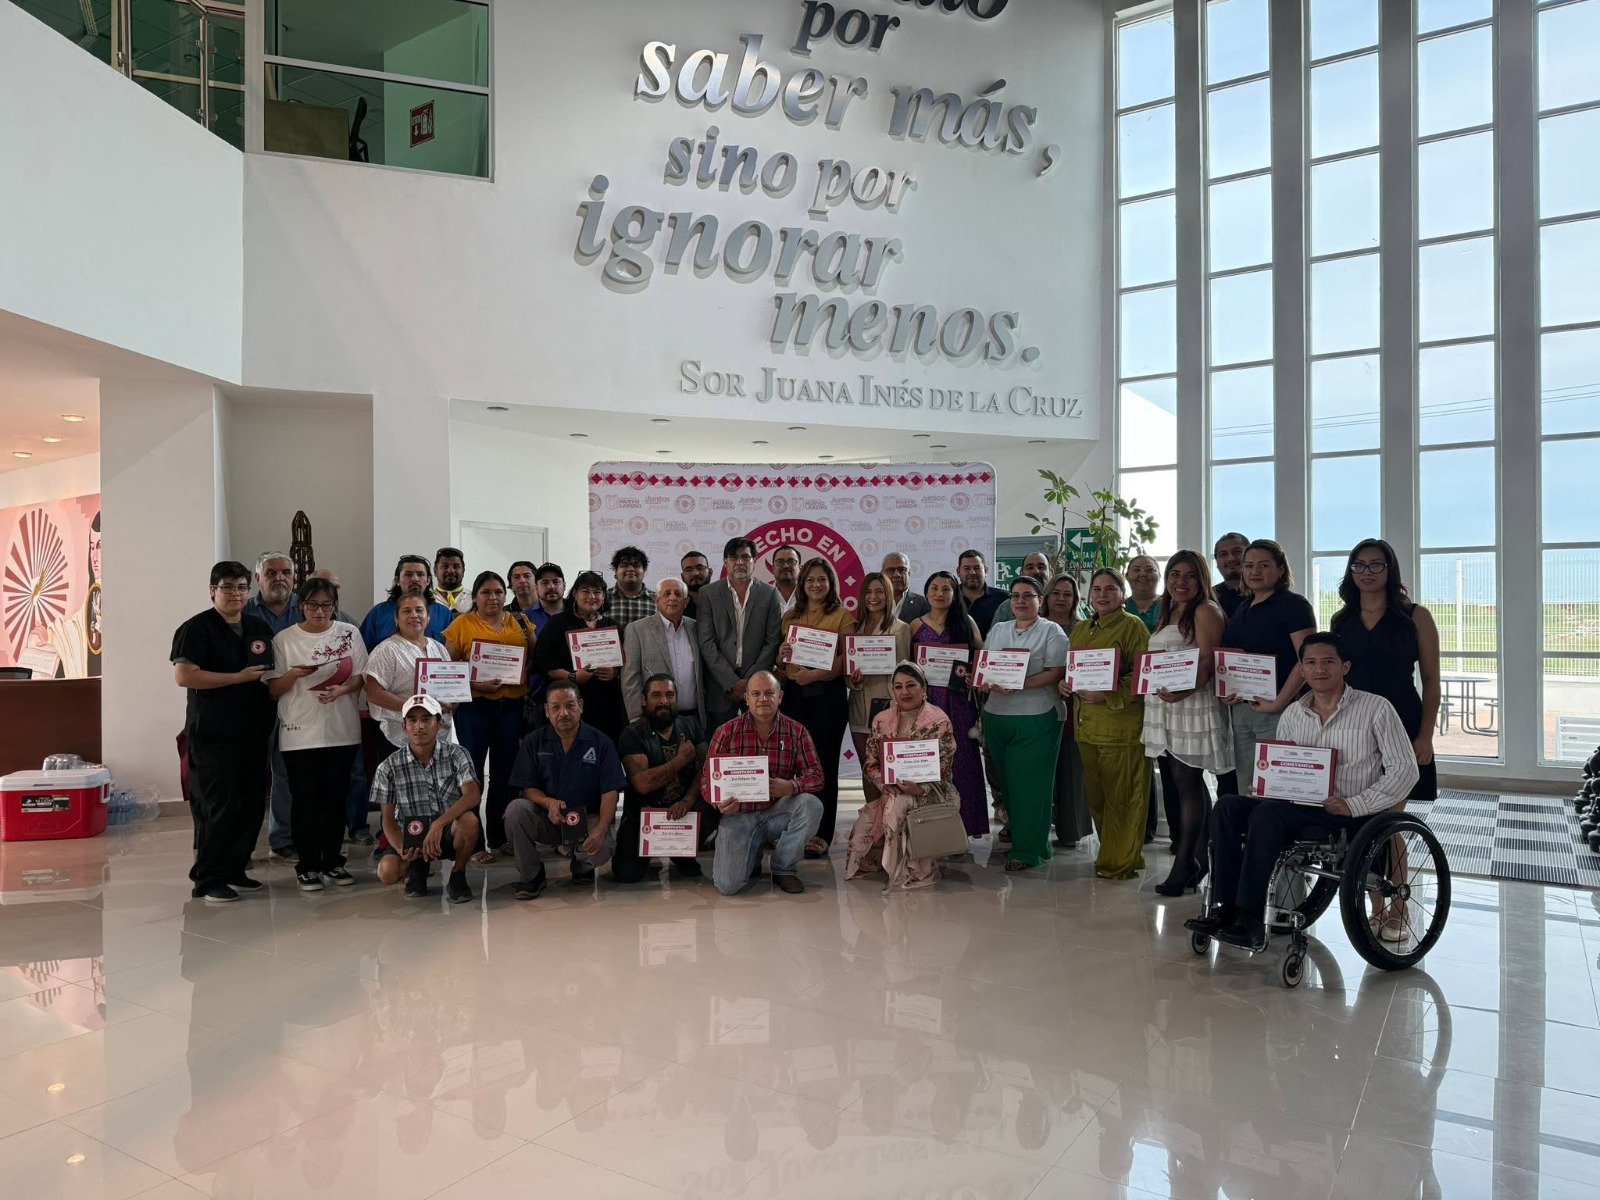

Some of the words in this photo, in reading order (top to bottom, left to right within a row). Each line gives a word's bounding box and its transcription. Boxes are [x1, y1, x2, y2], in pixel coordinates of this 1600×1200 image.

[789, 0, 901, 57] por
[634, 33, 869, 130] saber
[888, 79, 1062, 178] más,
[664, 126, 799, 197] sino
[808, 159, 918, 222] por
[574, 174, 904, 286] ignorar
[769, 292, 1043, 365] menos.
[680, 360, 748, 398] SOR
[756, 367, 855, 407] JUANA
[859, 375, 924, 411] INÉS
[929, 388, 965, 412] DE
[970, 390, 1001, 414] LA
[1008, 386, 1084, 420] CRUZ
[753, 526, 813, 553] ECHO
[816, 534, 847, 563] EN
[1280, 761, 1315, 769] CONSTANCIA
